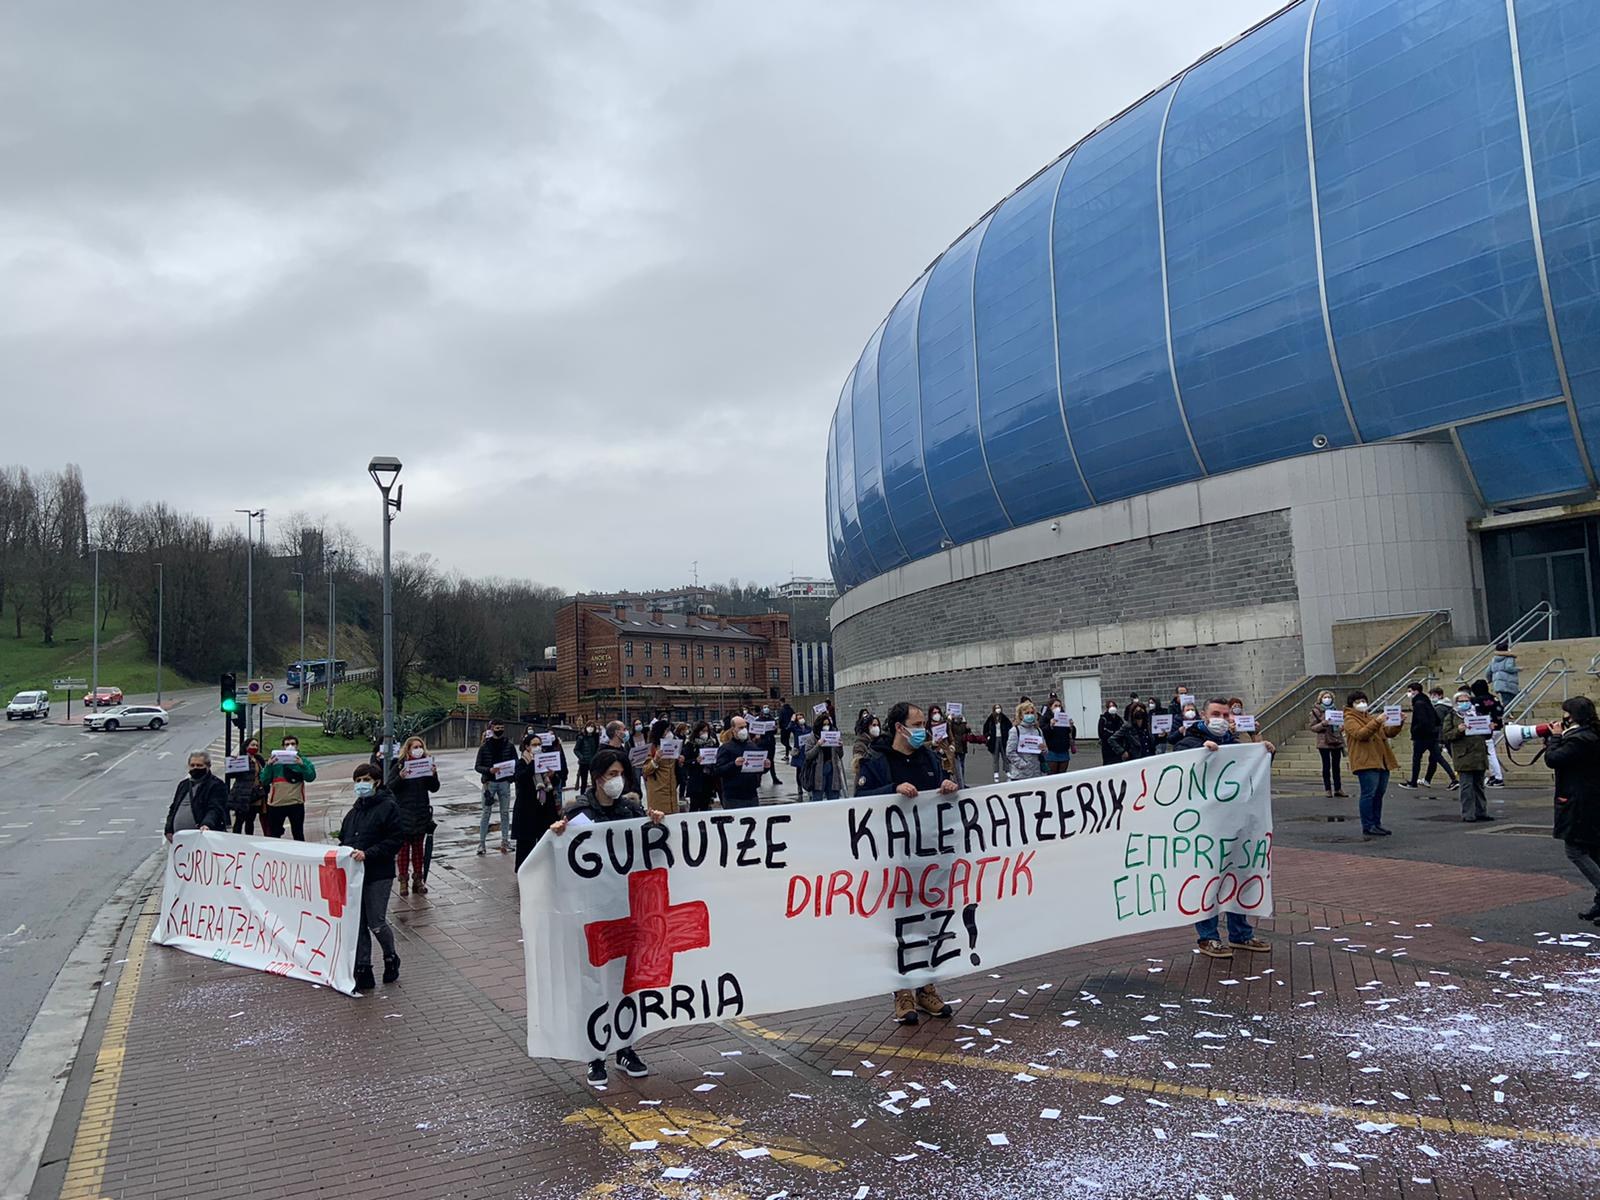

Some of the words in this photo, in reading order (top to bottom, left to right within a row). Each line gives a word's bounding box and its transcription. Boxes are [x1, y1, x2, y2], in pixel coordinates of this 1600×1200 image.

[567, 815, 792, 878] GURUTZE
[848, 778, 1128, 861] KALERATZERIK
[173, 844, 246, 890] GURUTZE
[251, 853, 312, 902] GORRIAN
[785, 851, 1036, 918] DIRUAGATIK
[1112, 873, 1167, 920] ELA
[1177, 872, 1265, 916] CCOO
[895, 903, 981, 975] EZ!
[587, 972, 744, 1051] GORRIA
